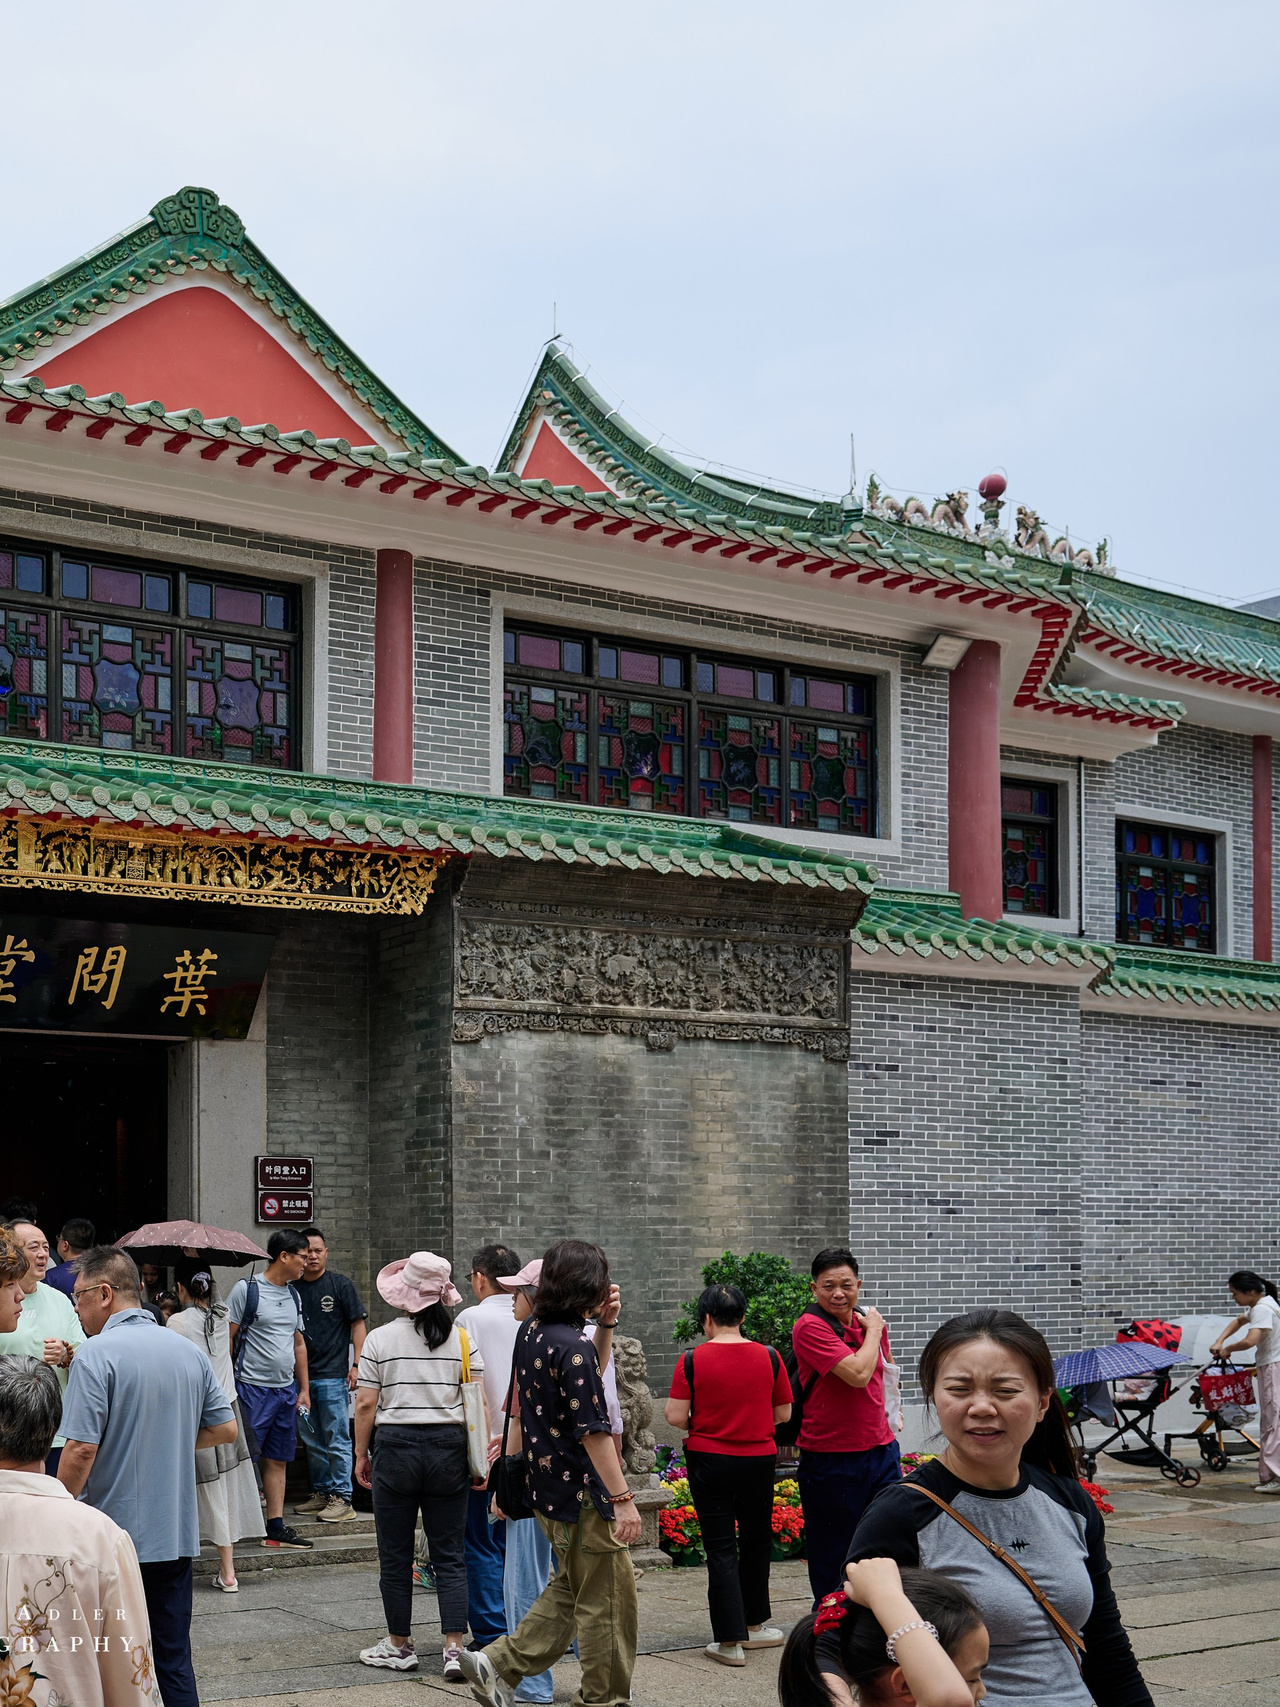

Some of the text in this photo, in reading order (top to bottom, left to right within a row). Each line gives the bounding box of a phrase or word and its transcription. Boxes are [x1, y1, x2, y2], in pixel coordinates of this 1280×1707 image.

[265, 1165, 306, 1175] 叶问堂入口
[282, 1200, 308, 1208] 禁止吸烟
